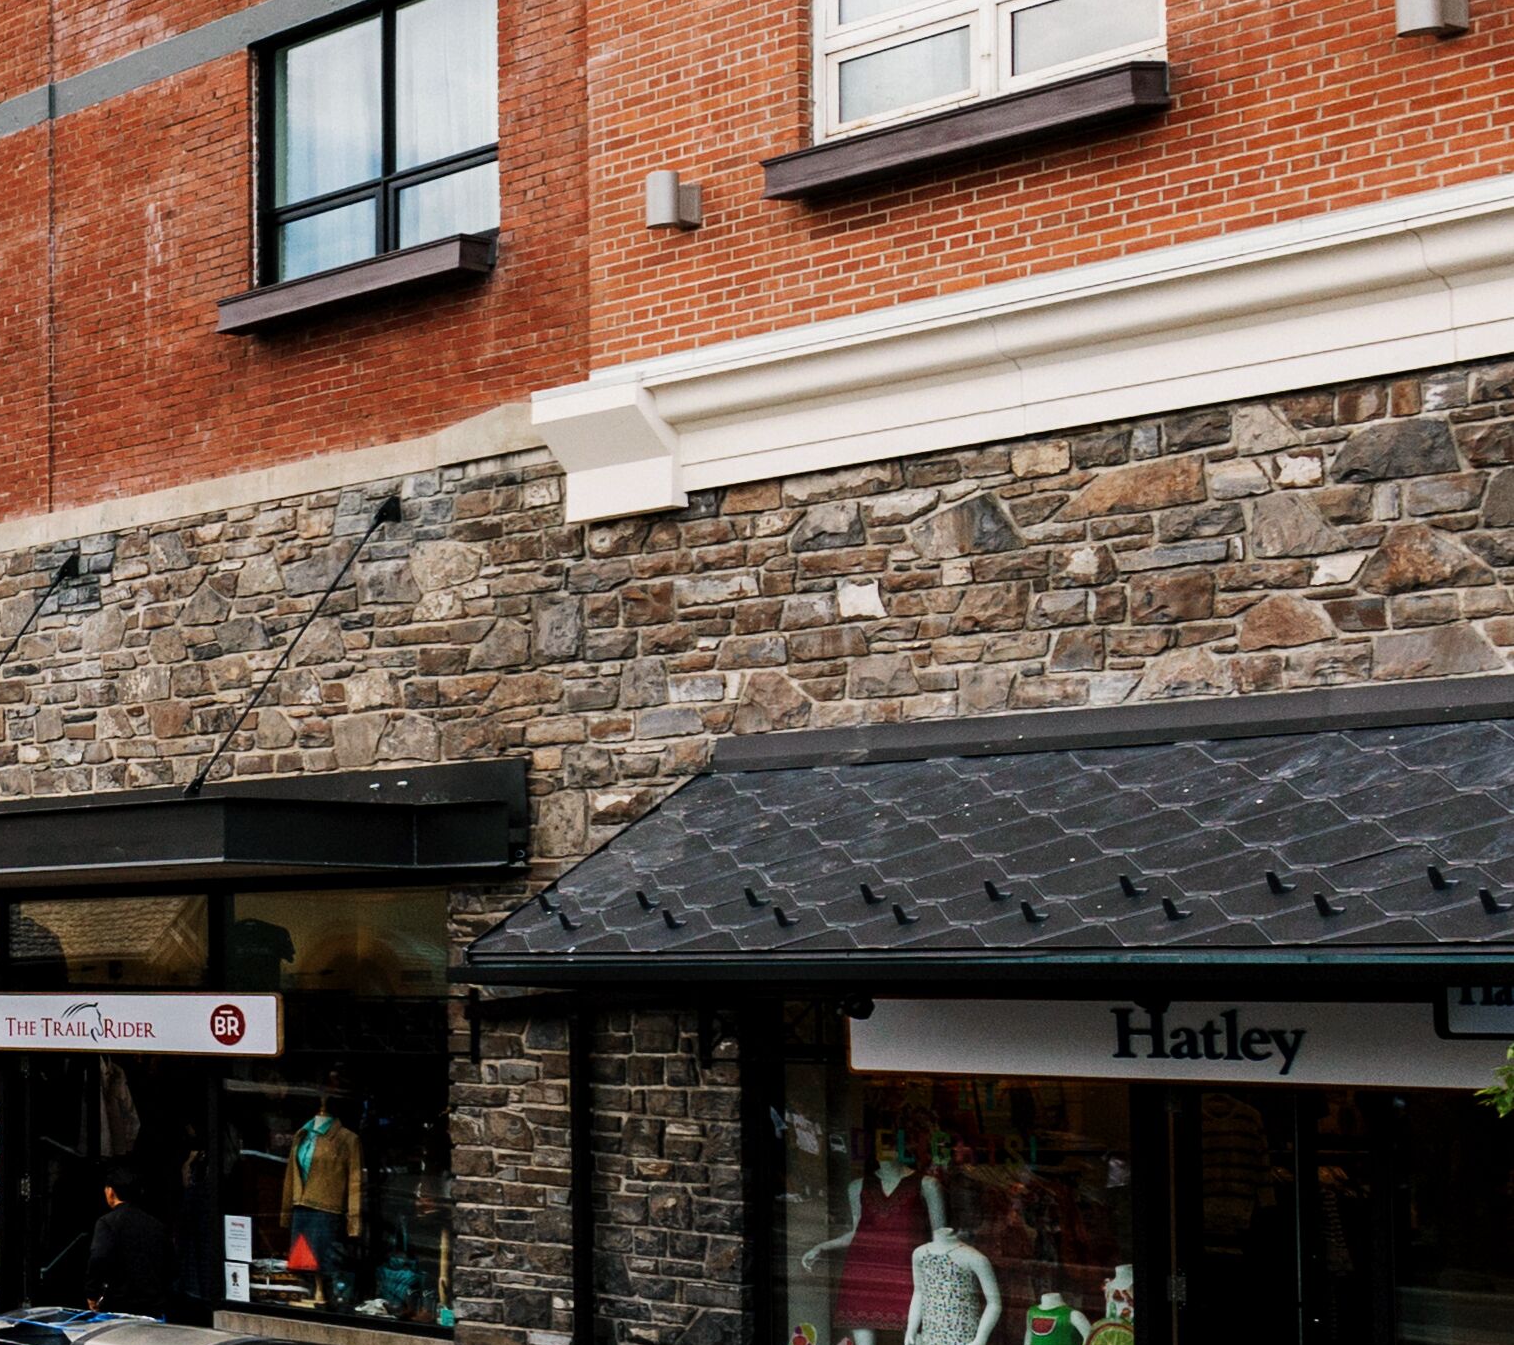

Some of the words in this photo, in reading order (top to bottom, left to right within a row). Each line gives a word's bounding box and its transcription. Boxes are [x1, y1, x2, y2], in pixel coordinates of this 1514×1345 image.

[5, 1017, 37, 1037] THE
[41, 1017, 90, 1038] TRAIL
[104, 1018, 157, 1039] RIDER
[214, 1015, 240, 1038] BR
[1110, 1007, 1307, 1075] Hatley
